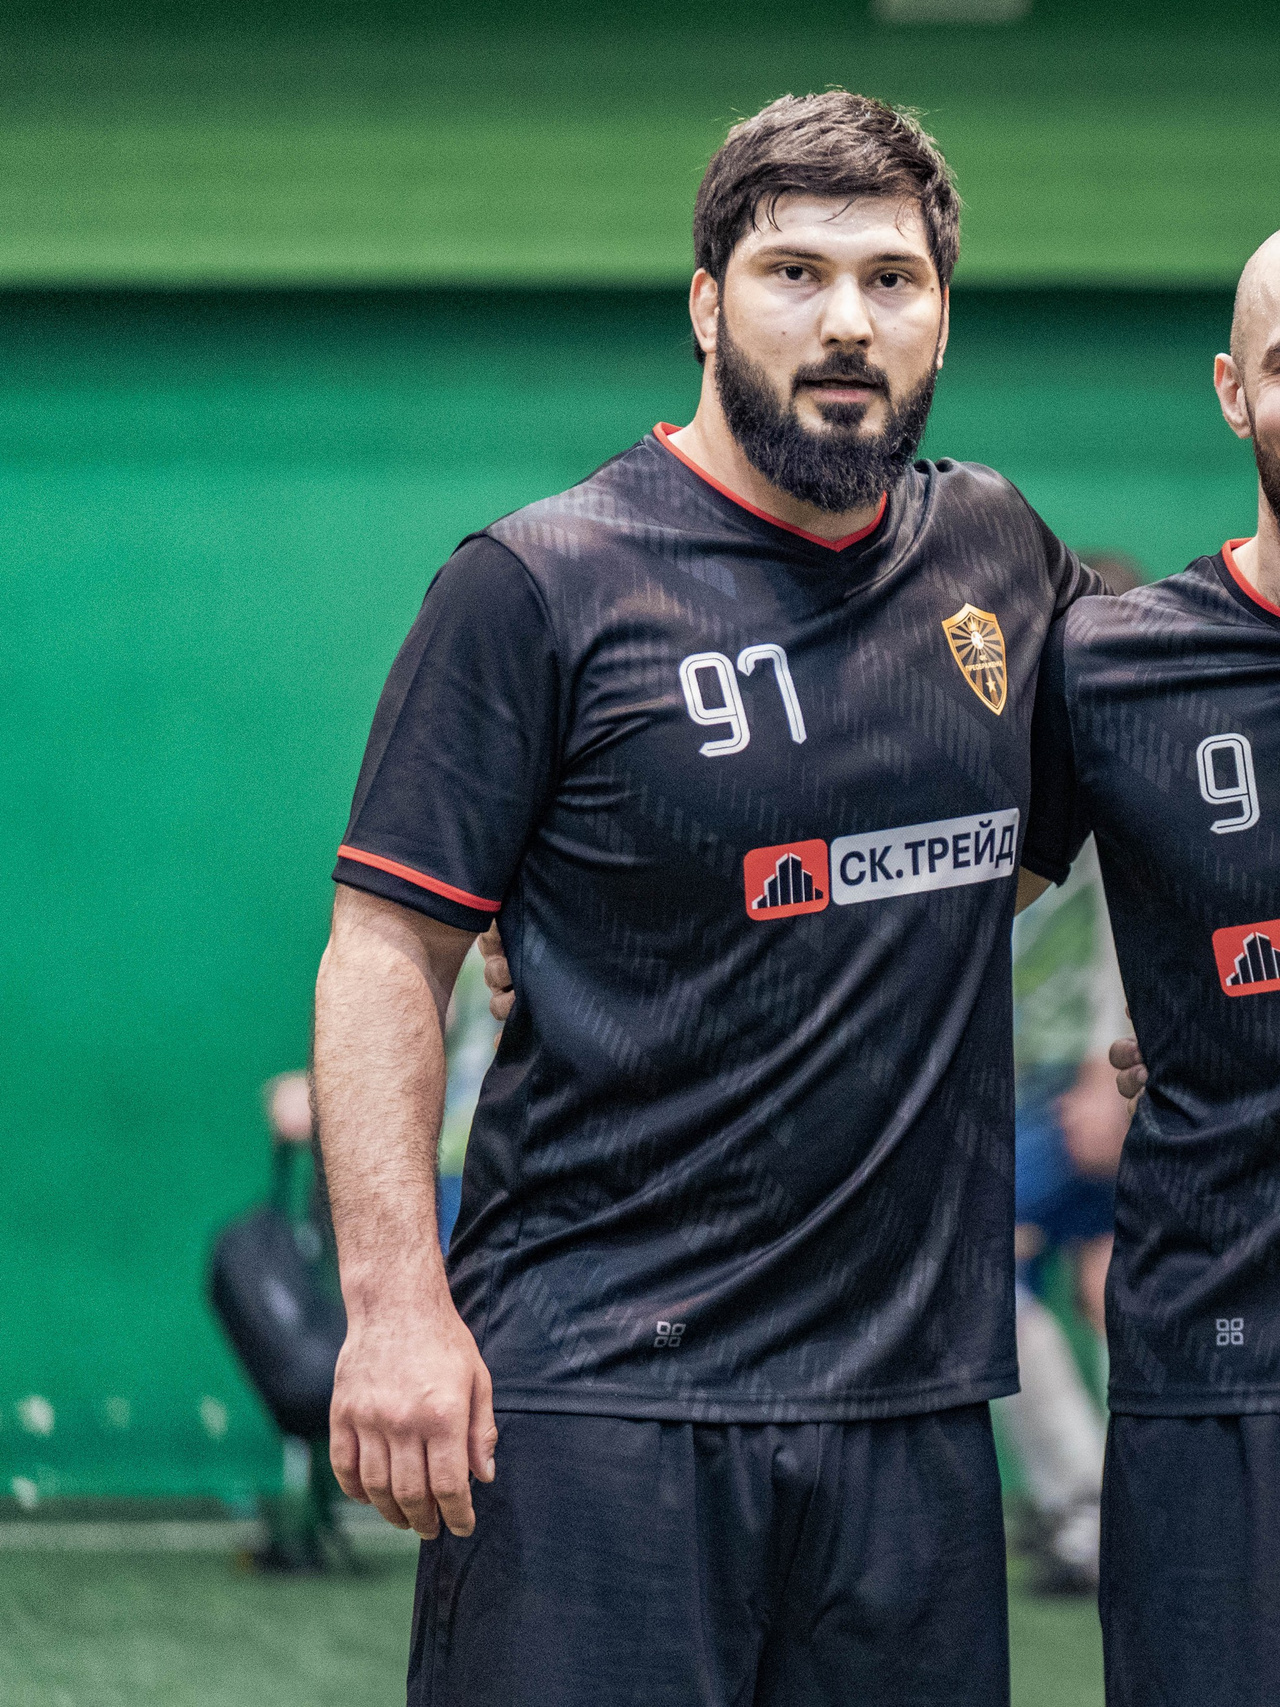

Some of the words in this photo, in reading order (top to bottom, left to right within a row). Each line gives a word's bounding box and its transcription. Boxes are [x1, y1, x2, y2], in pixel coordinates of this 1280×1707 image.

[679, 643, 807, 757] 97
[1196, 733, 1260, 834] 9
[840, 820, 1015, 886] СК.ТРЕЙД
